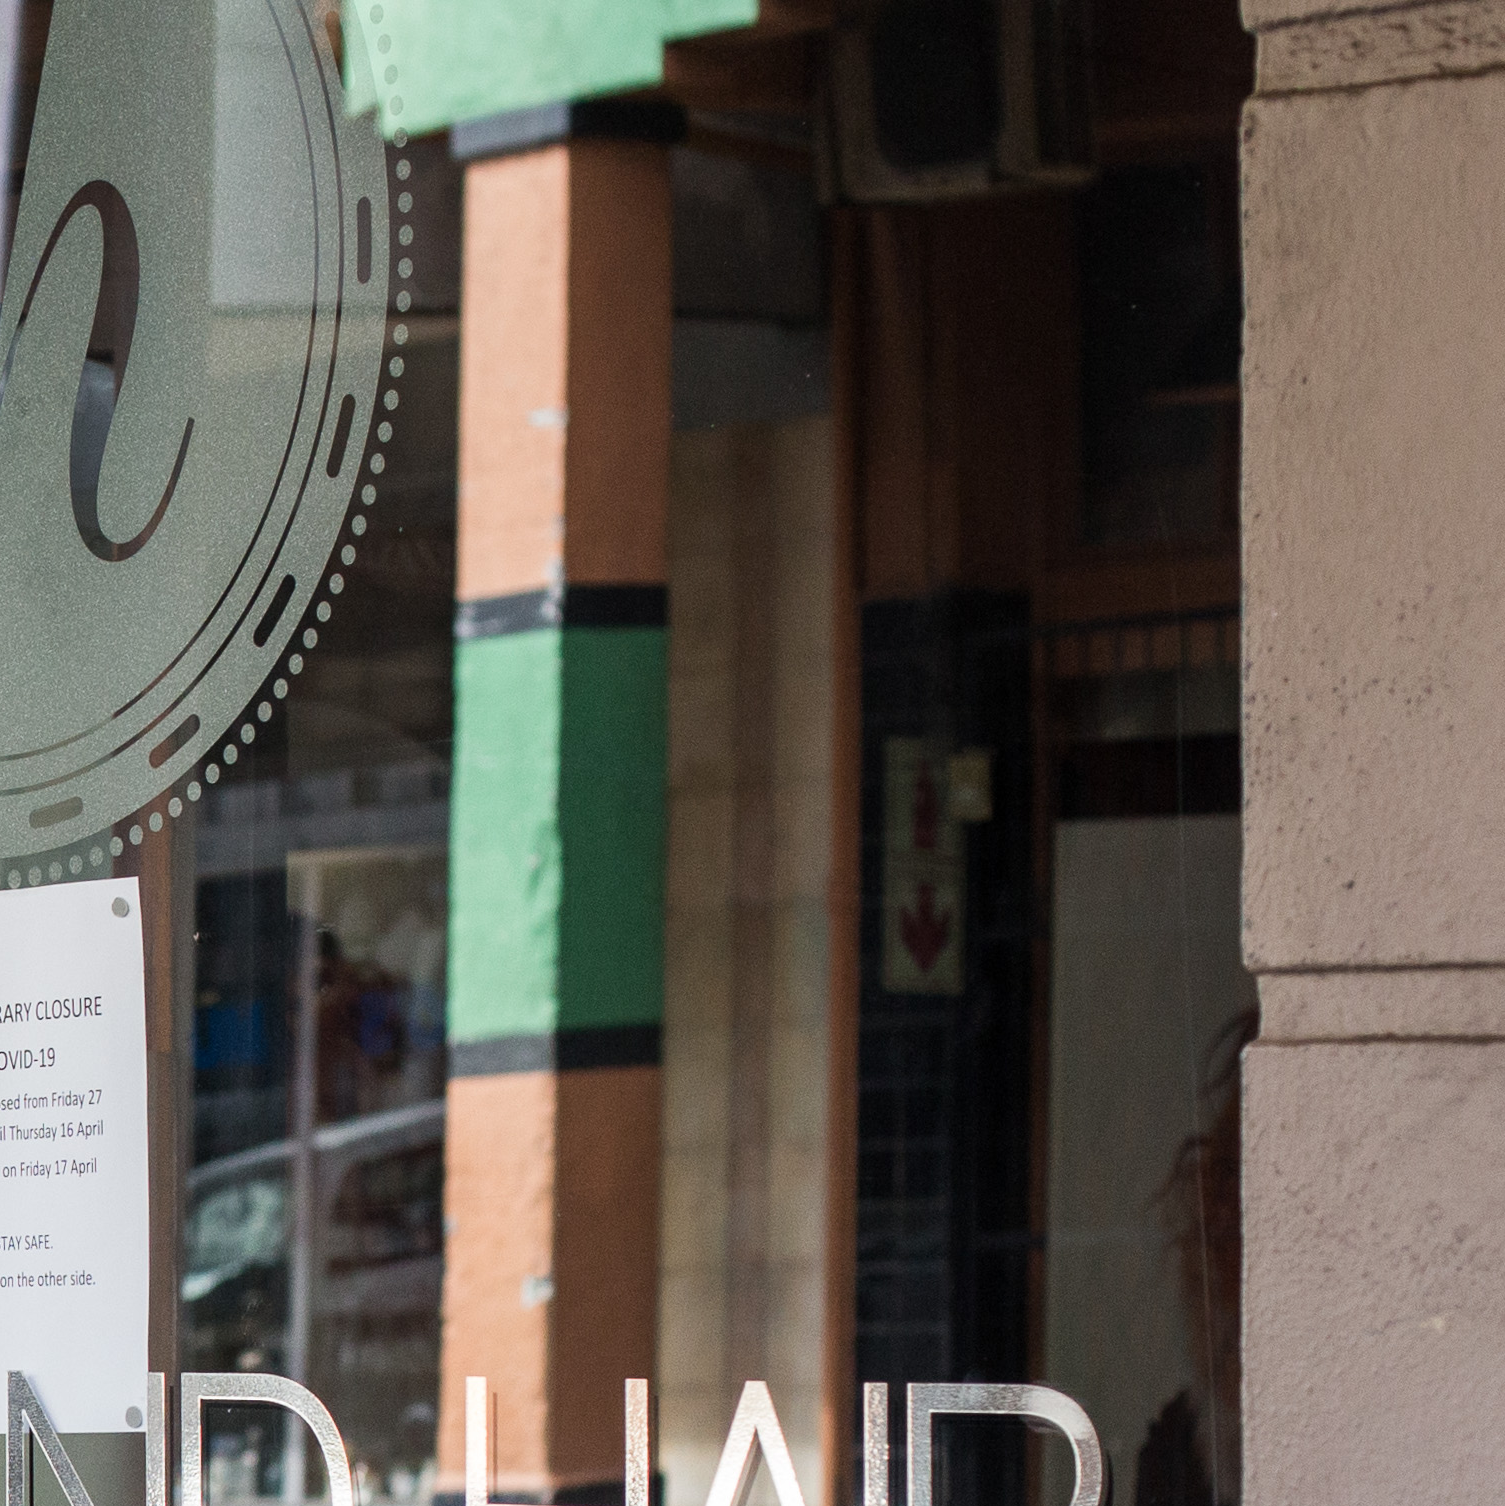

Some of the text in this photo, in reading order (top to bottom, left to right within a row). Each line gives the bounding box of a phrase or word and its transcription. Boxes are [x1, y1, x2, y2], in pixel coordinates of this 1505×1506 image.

[35, 996, 103, 1021] CLOSURE
[23, 1093, 49, 1109] from
[51, 1090, 85, 1109] Friday
[88, 1089, 103, 1105] 27
[9, 1122, 57, 1142] Thursday
[60, 1122, 74, 1138] 16
[76, 1119, 104, 1140] April
[2, 1165, 17, 1178] on
[20, 1160, 52, 1179] Friday
[54, 1159, 68, 1175] 17
[70, 1157, 97, 1177] April
[24, 1234, 54, 1250] SAFE.
[0, 1275, 14, 1288] on
[17, 1271, 35, 1287] the
[37, 1270, 68, 1287] other
[70, 1269, 96, 1286] side.
